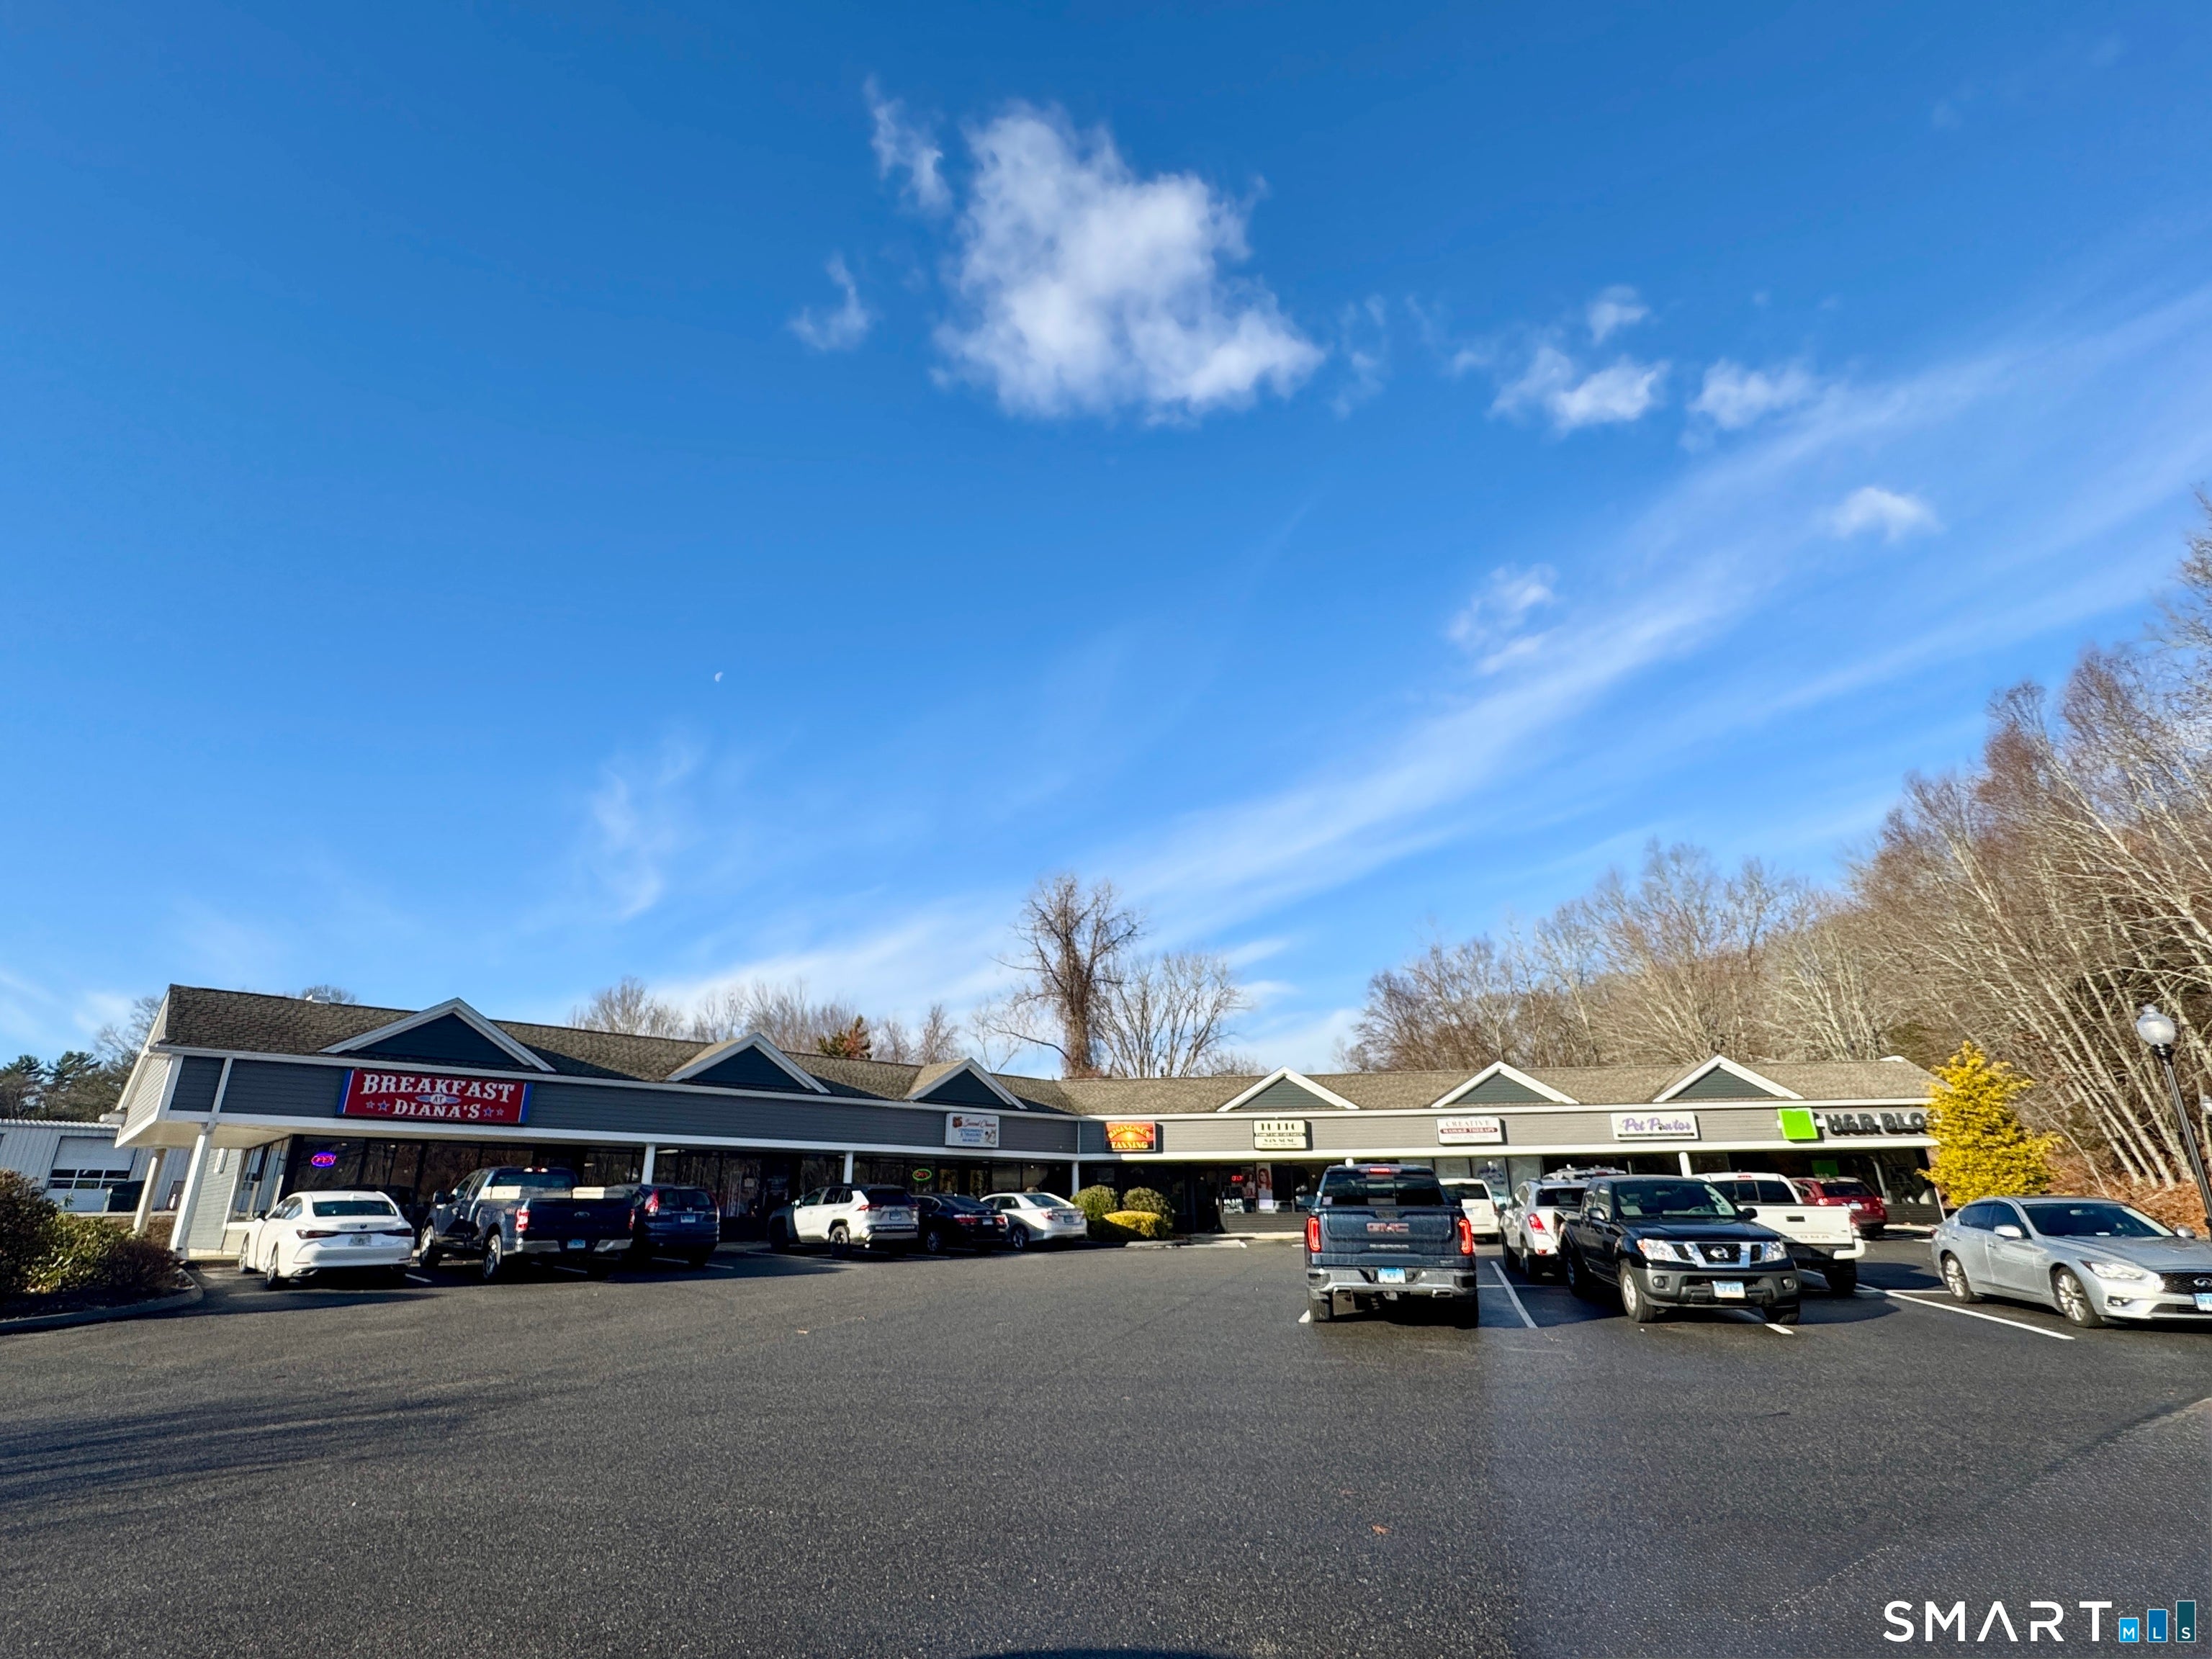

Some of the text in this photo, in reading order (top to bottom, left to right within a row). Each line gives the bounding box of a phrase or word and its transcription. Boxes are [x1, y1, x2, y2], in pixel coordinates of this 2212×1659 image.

[359, 1073, 516, 1103] BREAKFAST
[433, 1095, 445, 1104] AT
[392, 1097, 482, 1120] DIANA'S
[1622, 1117, 1645, 1131] Pet
[1824, 1112, 1928, 1132] H&R BLO
[1107, 1125, 1151, 1139] RISING SUN
[1110, 1141, 1148, 1149] TANNING
[311, 1154, 336, 1166] OPEN
[1366, 1222, 1410, 1233] GMC
